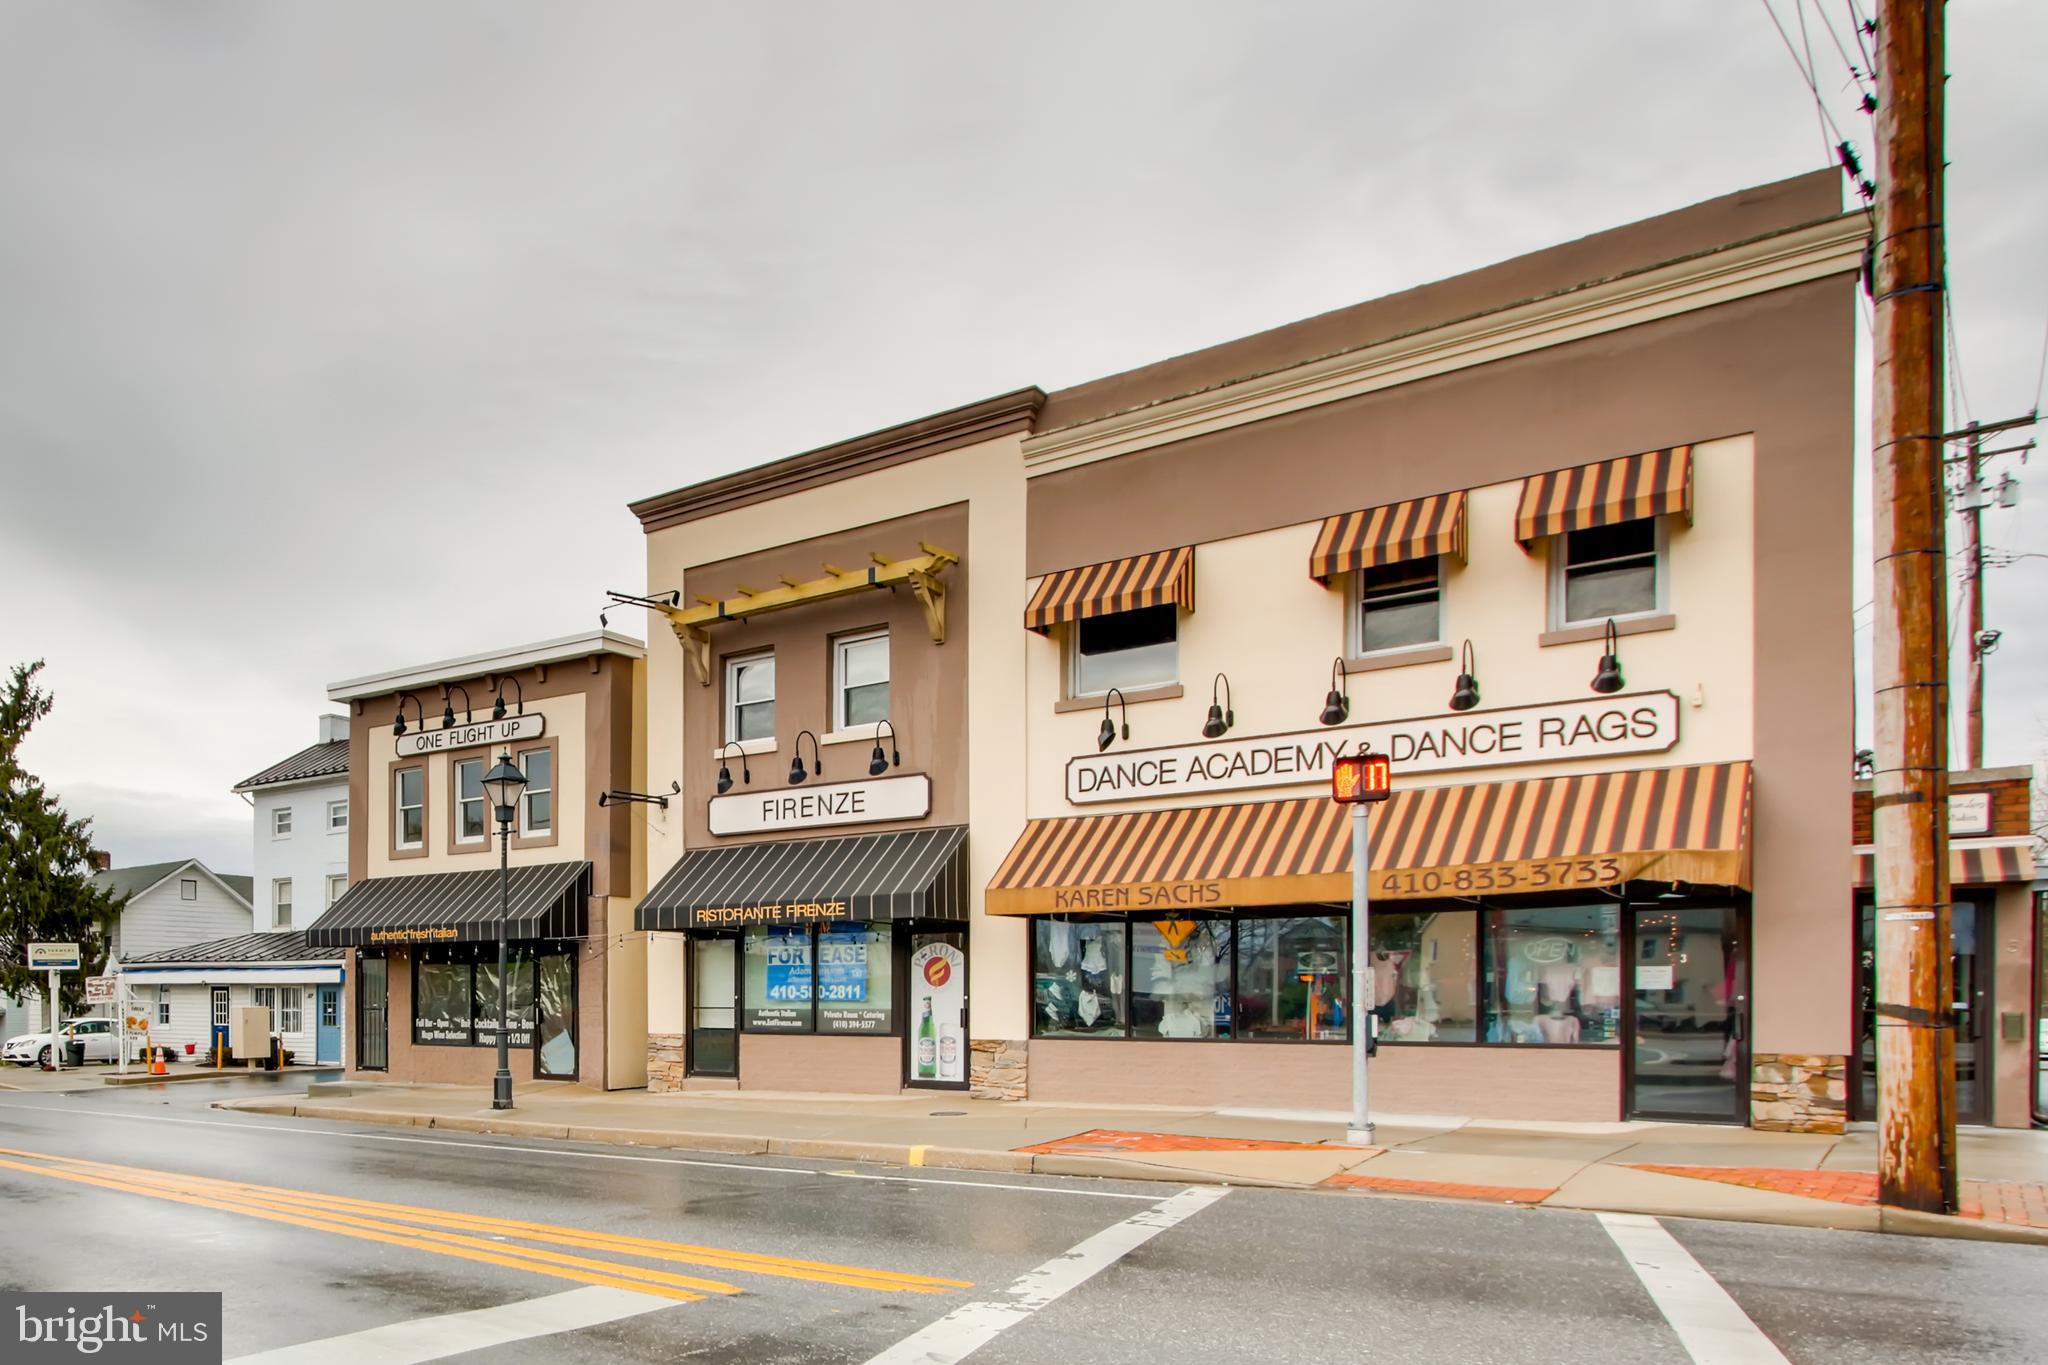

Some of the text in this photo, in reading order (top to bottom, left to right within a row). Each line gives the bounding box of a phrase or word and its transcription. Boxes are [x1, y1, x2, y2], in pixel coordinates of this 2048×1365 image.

[415, 721, 520, 751] ONE FLIGHT UP
[1077, 758, 1178, 793] DANCE
[1186, 739, 1349, 783] ACADEMY
[1390, 721, 1523, 763] DANCE
[1538, 708, 1659, 748] RAGS
[762, 790, 866, 822] FIRENZE
[1382, 858, 1621, 893] 410-833-3733
[1055, 883, 1221, 909] KAREN SACHS
[696, 901, 846, 923] RISTORANTE FIRENZE
[768, 948, 804, 965] FOR
[1679, 953, 1688, 964] 3
[478, 1032, 496, 1045] Happy
